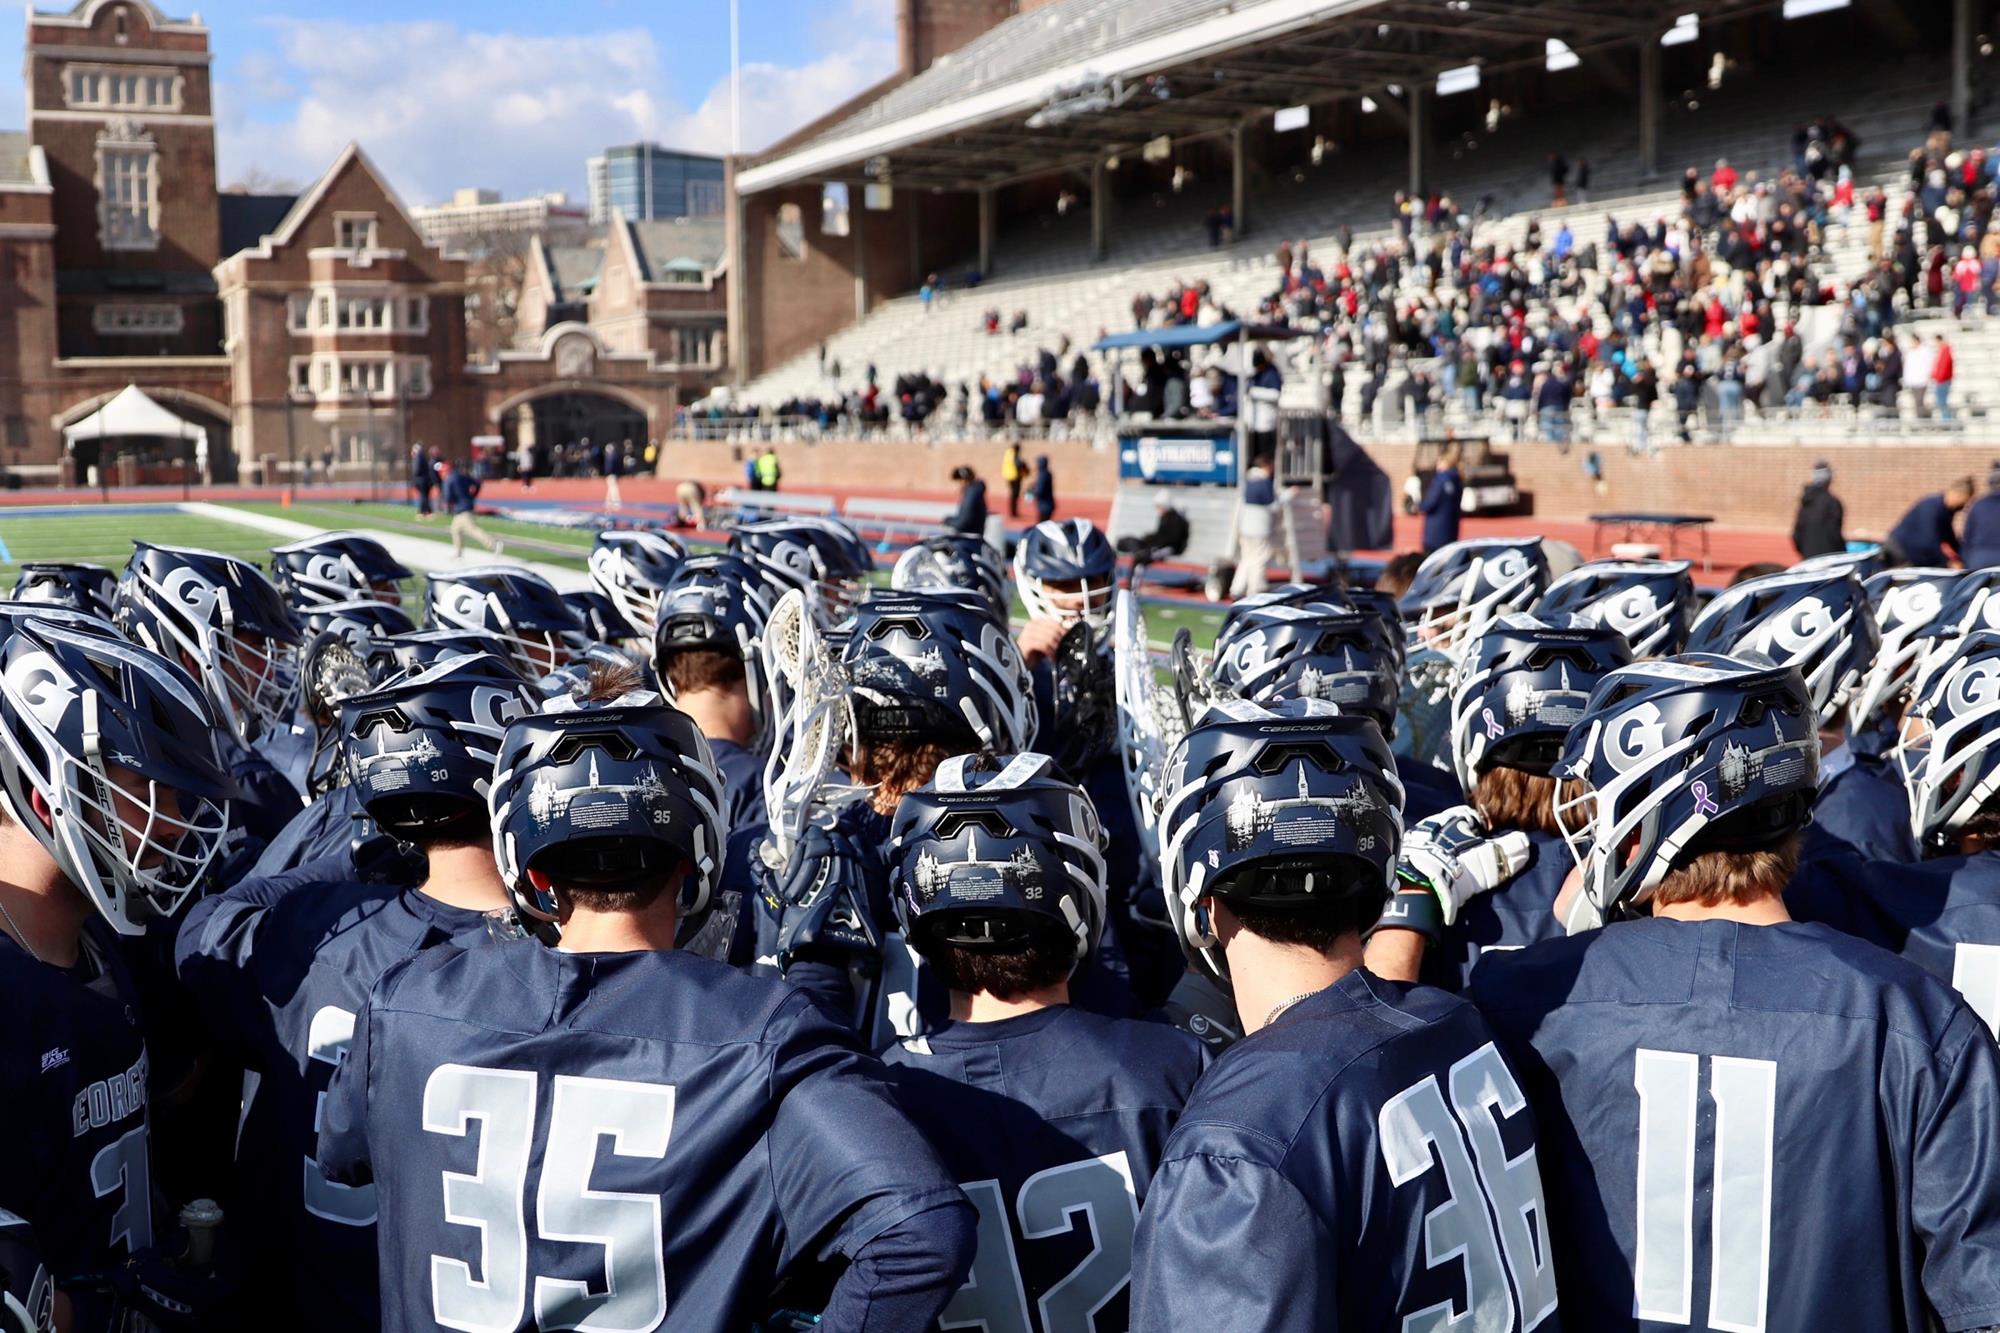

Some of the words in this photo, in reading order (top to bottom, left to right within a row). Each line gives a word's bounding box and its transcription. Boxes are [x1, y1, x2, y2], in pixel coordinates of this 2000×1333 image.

[162, 567, 219, 625] G
[306, 554, 350, 592] G
[441, 584, 488, 630] G
[1604, 584, 1657, 632] G
[1771, 596, 1833, 653] G
[1228, 630, 1268, 684] G
[4, 651, 80, 733] G
[934, 686, 948, 698] 21
[1947, 657, 2000, 718] G
[554, 714, 624, 725] cascade
[1259, 724, 1332, 733] cascade
[1603, 702, 1666, 774] G
[431, 769, 448, 782] 30
[653, 810, 671, 824] 35
[1359, 835, 1375, 851] 36
[1025, 886, 1044, 900] 32
[42, 1047, 60, 1061] BIG
[42, 1049, 69, 1068] EAST
[423, 1063, 675, 1333] 35
[1379, 1041, 1558, 1333] 36
[1633, 1047, 1776, 1333] 11
